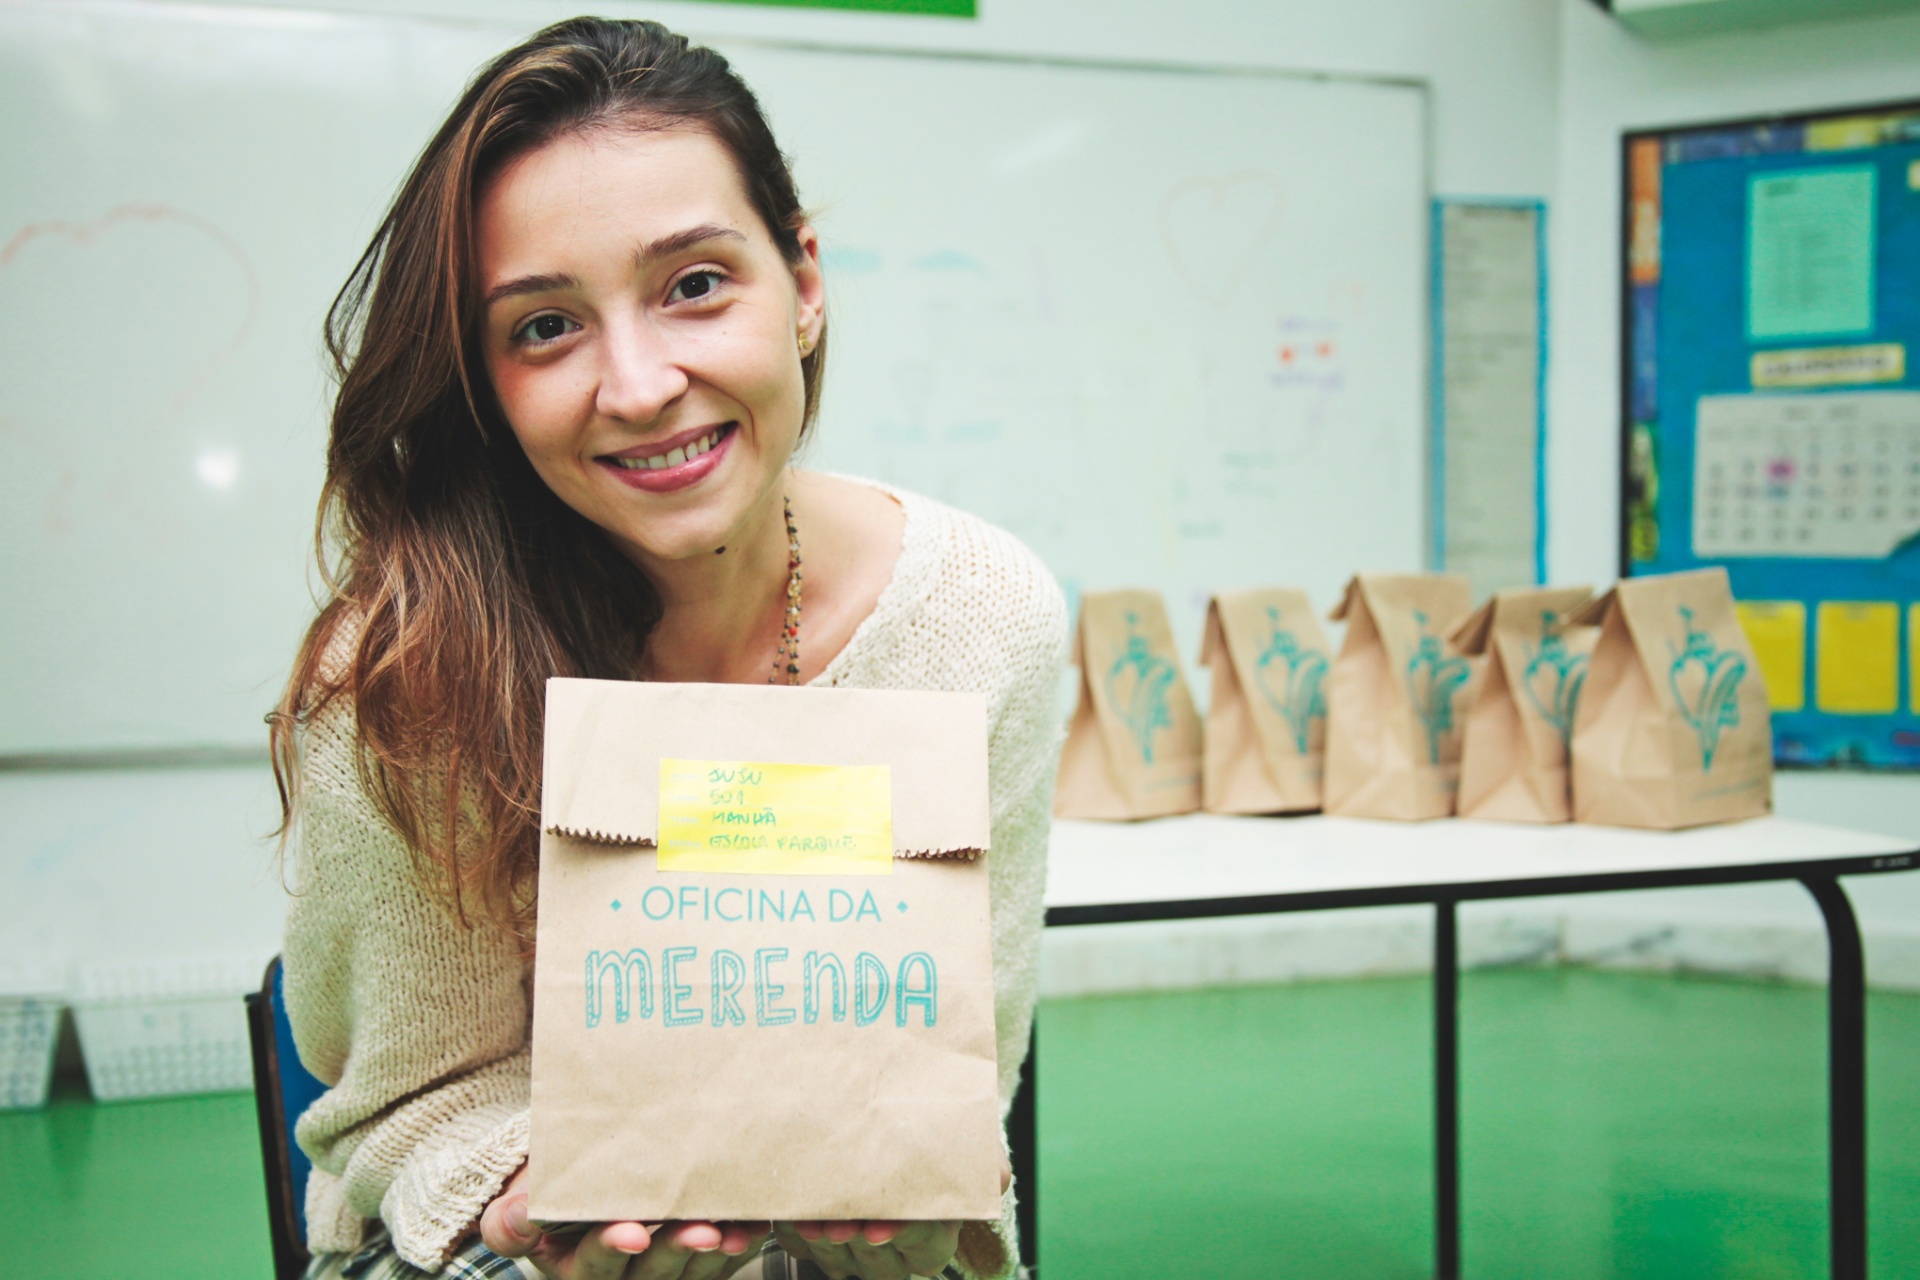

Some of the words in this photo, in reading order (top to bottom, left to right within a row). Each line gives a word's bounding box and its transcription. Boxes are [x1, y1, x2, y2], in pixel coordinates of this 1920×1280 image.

[641, 886, 816, 922] OFICINA
[828, 889, 882, 922] DA
[584, 946, 938, 1028] MERENDA
